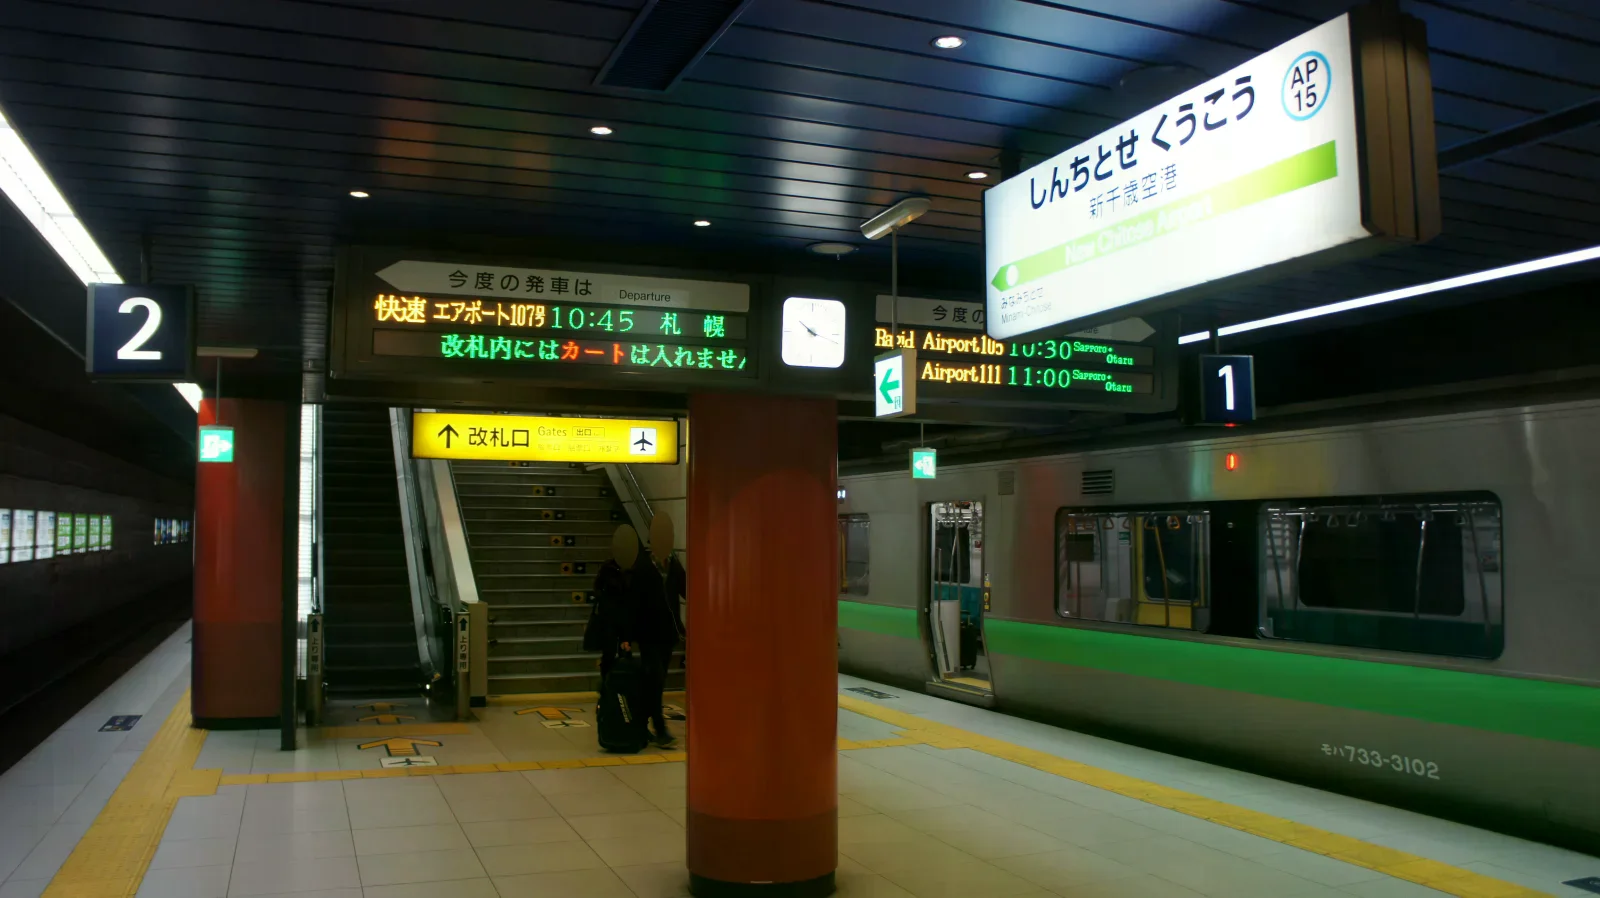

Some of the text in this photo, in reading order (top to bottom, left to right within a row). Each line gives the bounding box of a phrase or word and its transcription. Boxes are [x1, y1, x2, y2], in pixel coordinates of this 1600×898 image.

[1290, 58, 1318, 89] AP
[1294, 83, 1317, 112] 15
[1029, 75, 1256, 211] しんちとせ くうこう
[1089, 163, 1178, 220] 新千歳空港
[448, 269, 671, 302] 今度の発車は Departure
[117, 296, 163, 361] 2
[374, 293, 427, 324] 快速
[551, 306, 635, 332] 10:45
[1009, 340, 1072, 359] 10:30
[1106, 354, 1134, 366] Otaru
[1008, 366, 1070, 388] 11:00
[1105, 381, 1133, 393] Otaru
[1218, 364, 1234, 411] 1
[468, 426, 531, 448] 改札口
[537, 425, 568, 438] Gates
[576, 428, 593, 437] 出口
